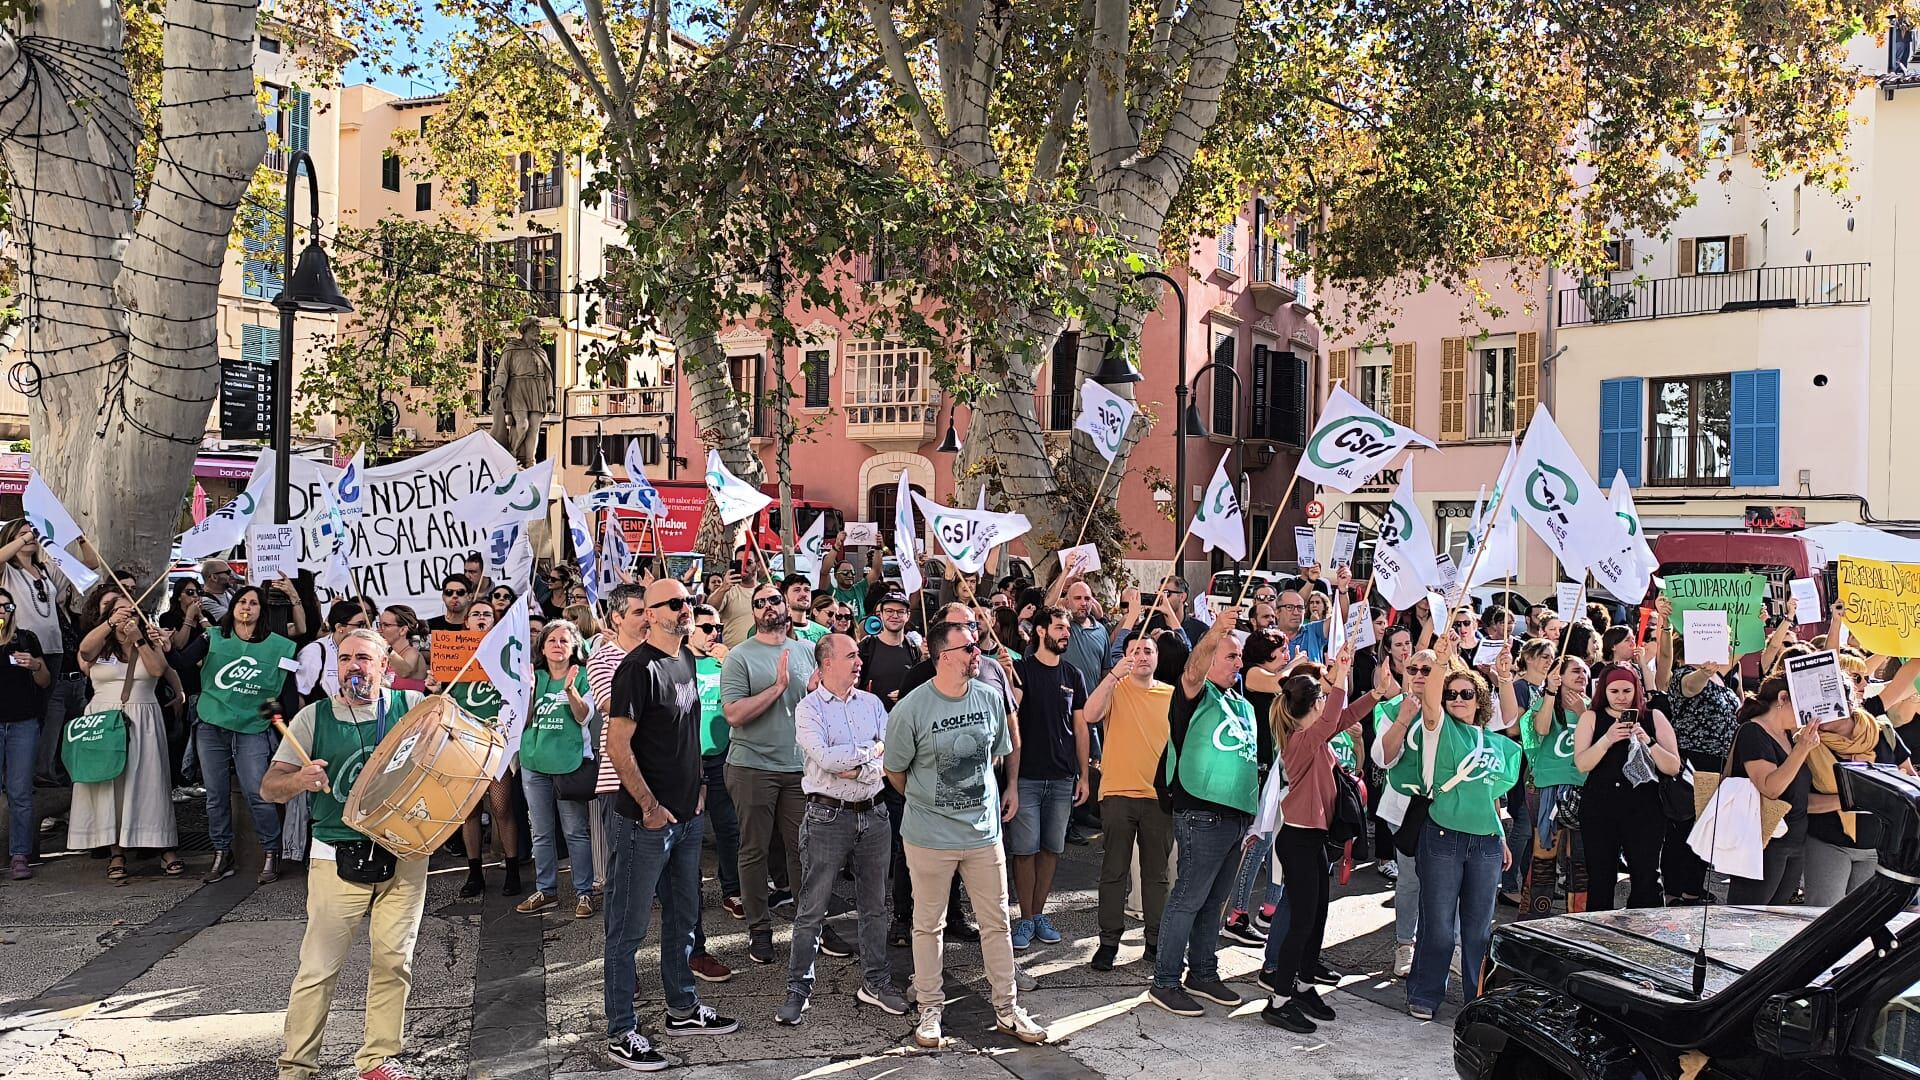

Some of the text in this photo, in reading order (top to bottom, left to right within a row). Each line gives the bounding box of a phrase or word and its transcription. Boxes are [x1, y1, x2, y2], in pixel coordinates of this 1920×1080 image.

[219, 469, 234, 477] bar
[657, 517, 688, 530] Mahou
[1377, 550, 1401, 574] ILLES
[1606, 556, 1623, 576] ILLES
[232, 687, 259, 696] BALEARS
[931, 721, 939, 730] A
[940, 714, 966, 728] GOLF
